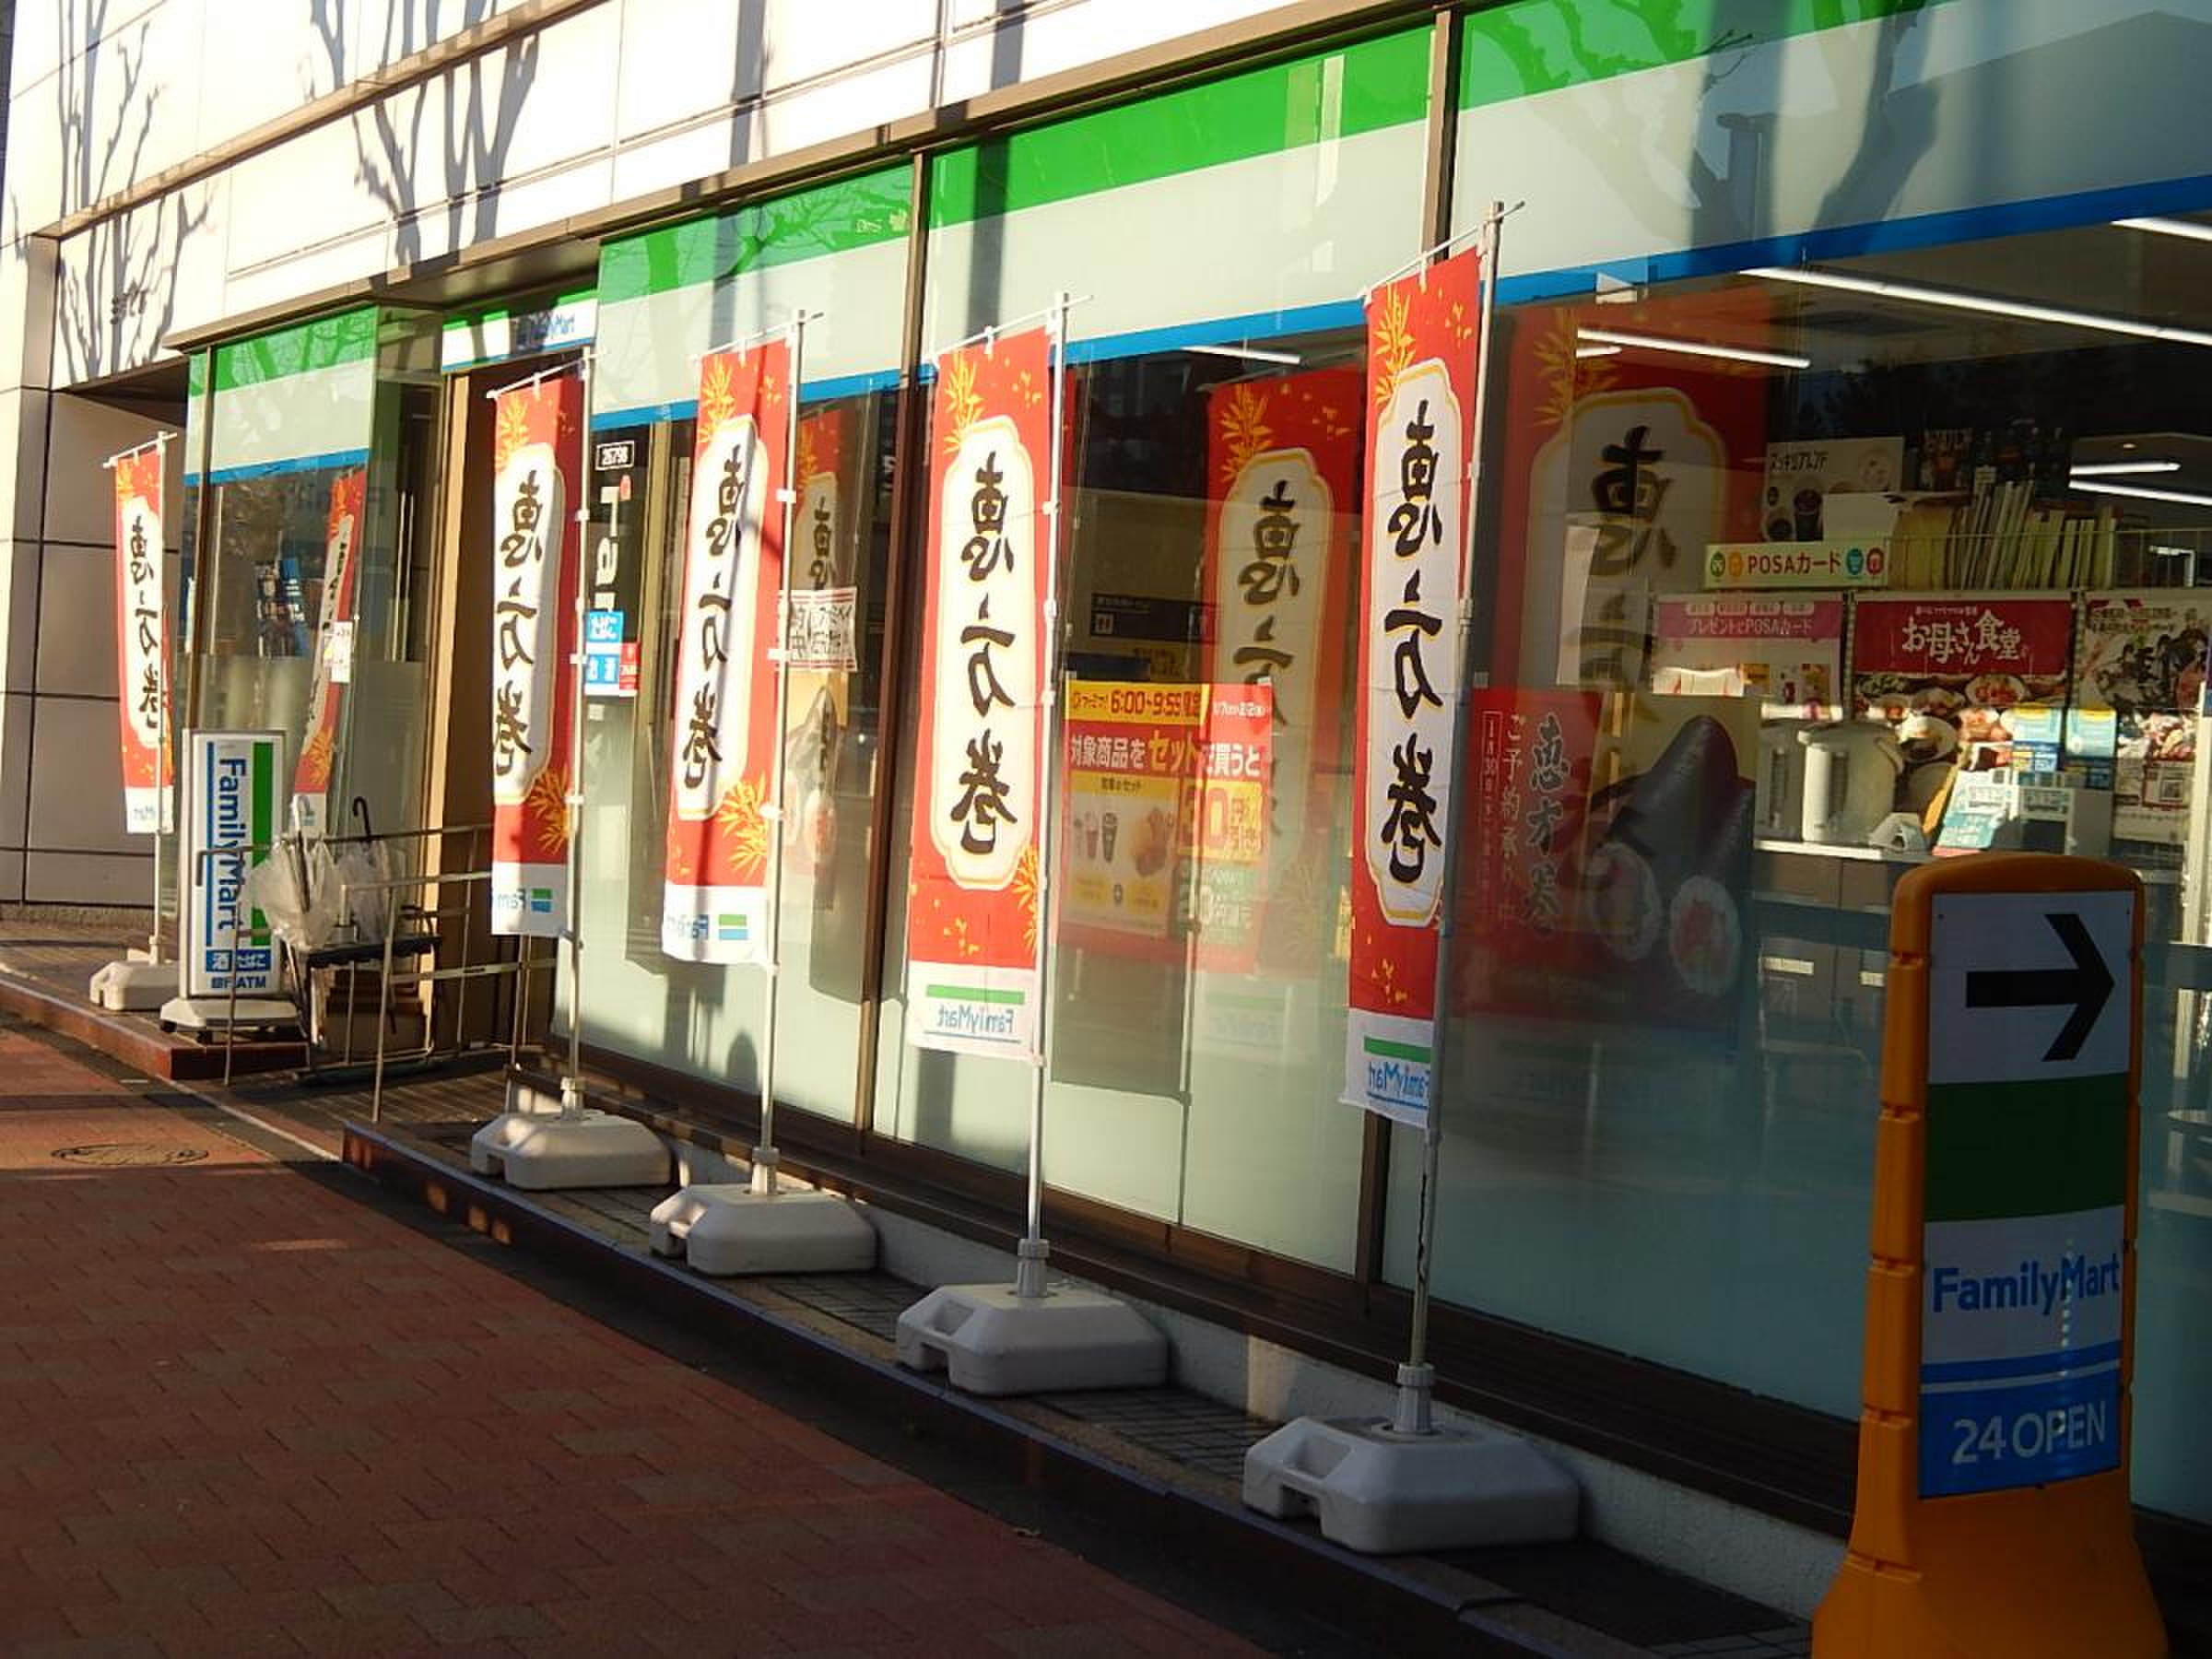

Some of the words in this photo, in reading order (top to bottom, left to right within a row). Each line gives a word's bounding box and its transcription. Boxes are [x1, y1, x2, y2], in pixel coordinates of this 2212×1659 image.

[1748, 553, 1842, 575] POSAカード
[1902, 609, 2021, 665] お母さん食堂
[218, 758, 247, 929] FamilyMart
[1933, 1254, 2120, 1316] FamilyMart
